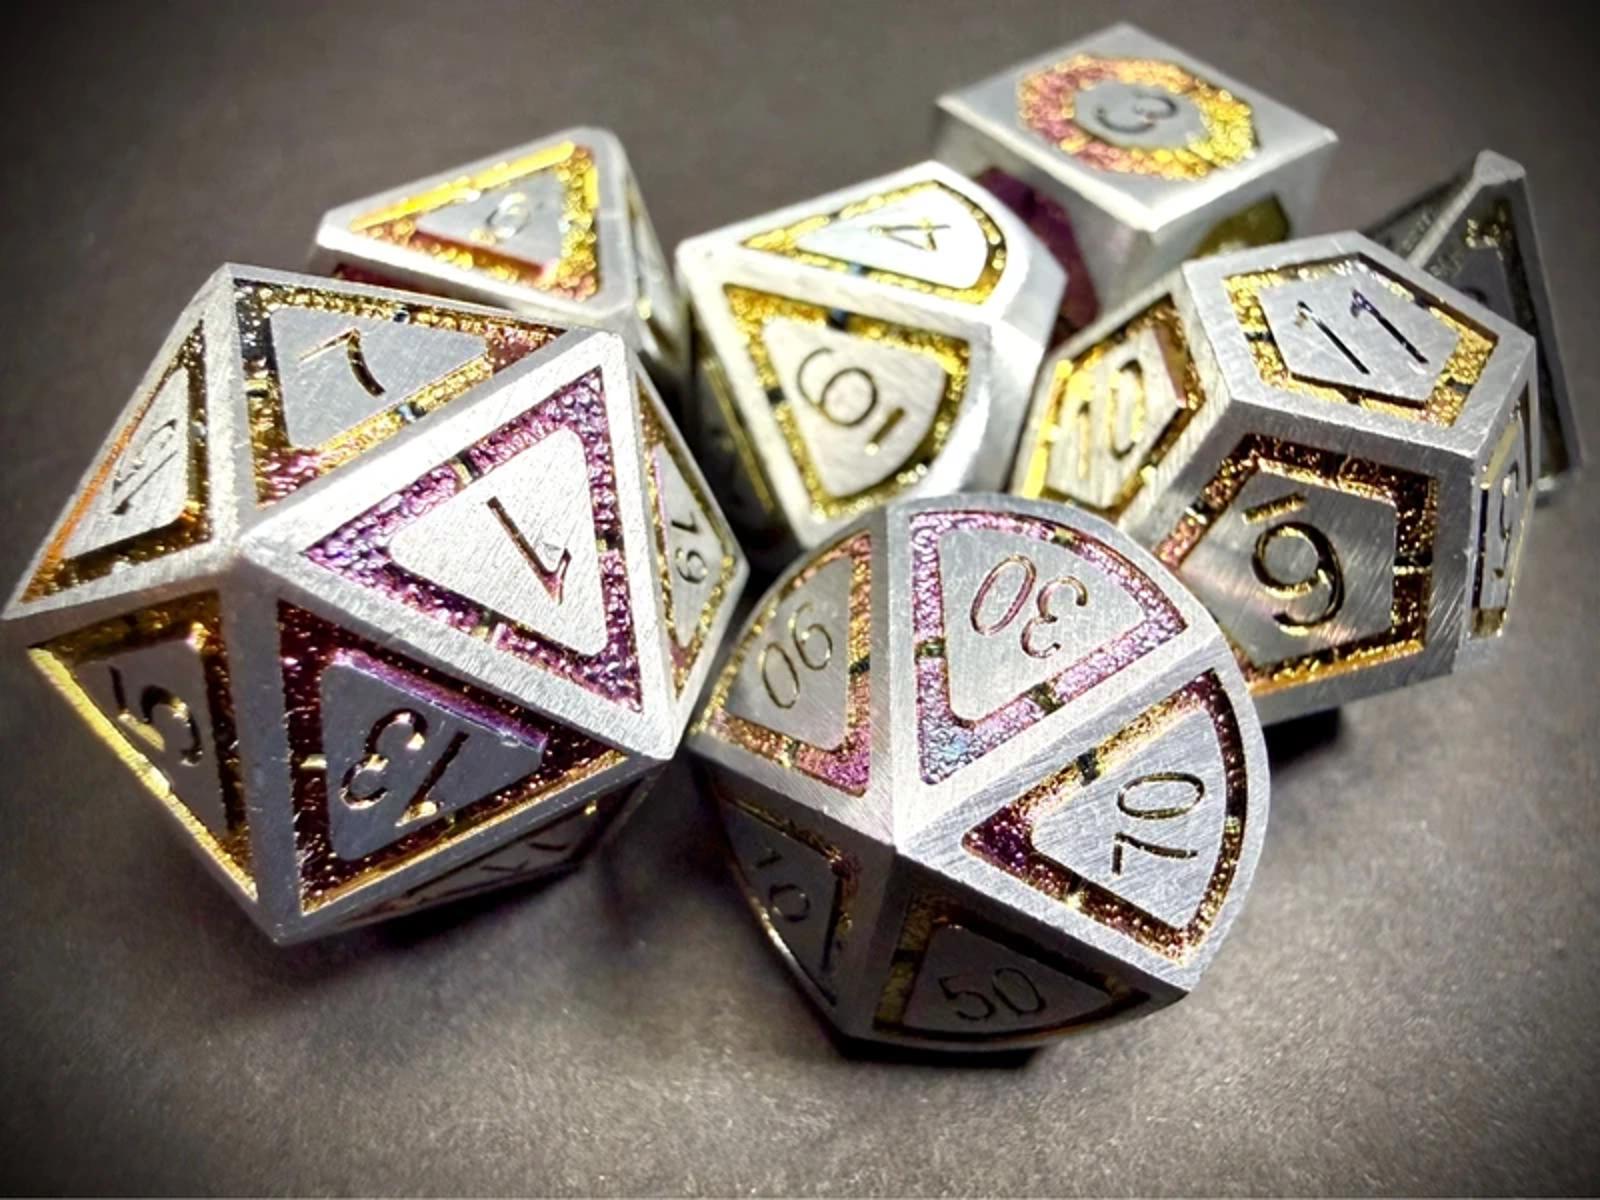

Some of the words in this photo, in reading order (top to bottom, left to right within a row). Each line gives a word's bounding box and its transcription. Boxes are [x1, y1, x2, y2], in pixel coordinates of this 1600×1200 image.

[1097, 93, 1177, 134] 3
[868, 217, 951, 251] 4
[299, 327, 386, 397] 7
[1295, 289, 1429, 376] 11
[1078, 358, 1146, 481] 10
[486, 496, 572, 607] 1
[671, 510, 708, 586] 19
[970, 555, 1089, 659] 30
[761, 603, 833, 710] 90
[339, 708, 469, 828] 13
[1110, 772, 1206, 876] 70
[939, 967, 1047, 1022] 50
